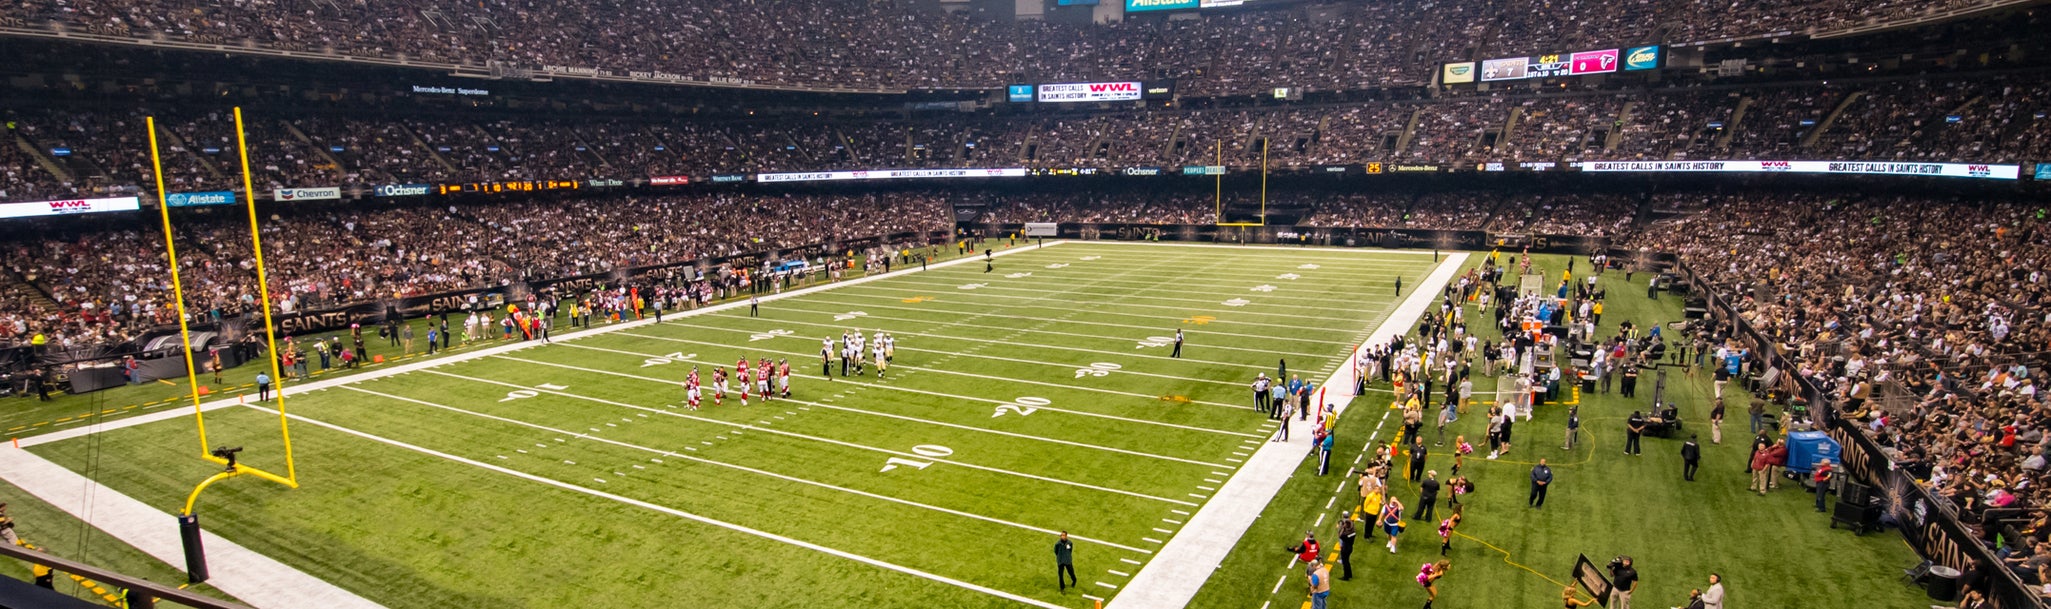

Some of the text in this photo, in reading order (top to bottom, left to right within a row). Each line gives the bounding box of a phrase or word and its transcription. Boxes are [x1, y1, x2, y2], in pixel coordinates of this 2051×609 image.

[1539, 55, 1559, 63] 4:21
[1507, 68, 1513, 76] 7
[1580, 62, 1586, 71] 0
[1089, 84, 1137, 92] WWL
[1127, 167, 1158, 175] Ochsner
[1368, 164, 1380, 172] 25
[1594, 162, 1725, 170] GREATEST CALLS IN SAINTS HISTORY
[1828, 163, 1942, 174] GREATEST CALLS IN SAINTS HISTORY
[297, 189, 334, 198] Chevron
[385, 185, 427, 196] Ochsner
[50, 200, 90, 208] WWL
[187, 193, 226, 205] Allstate
[729, 256, 755, 267] AINTS
[281, 311, 347, 334] SAINTS
[1076, 362, 1122, 377] 30
[996, 396, 1051, 416] 20
[885, 444, 953, 470] 10
[1835, 426, 1870, 480] SAINTS
[1925, 521, 1975, 573] SAIN
